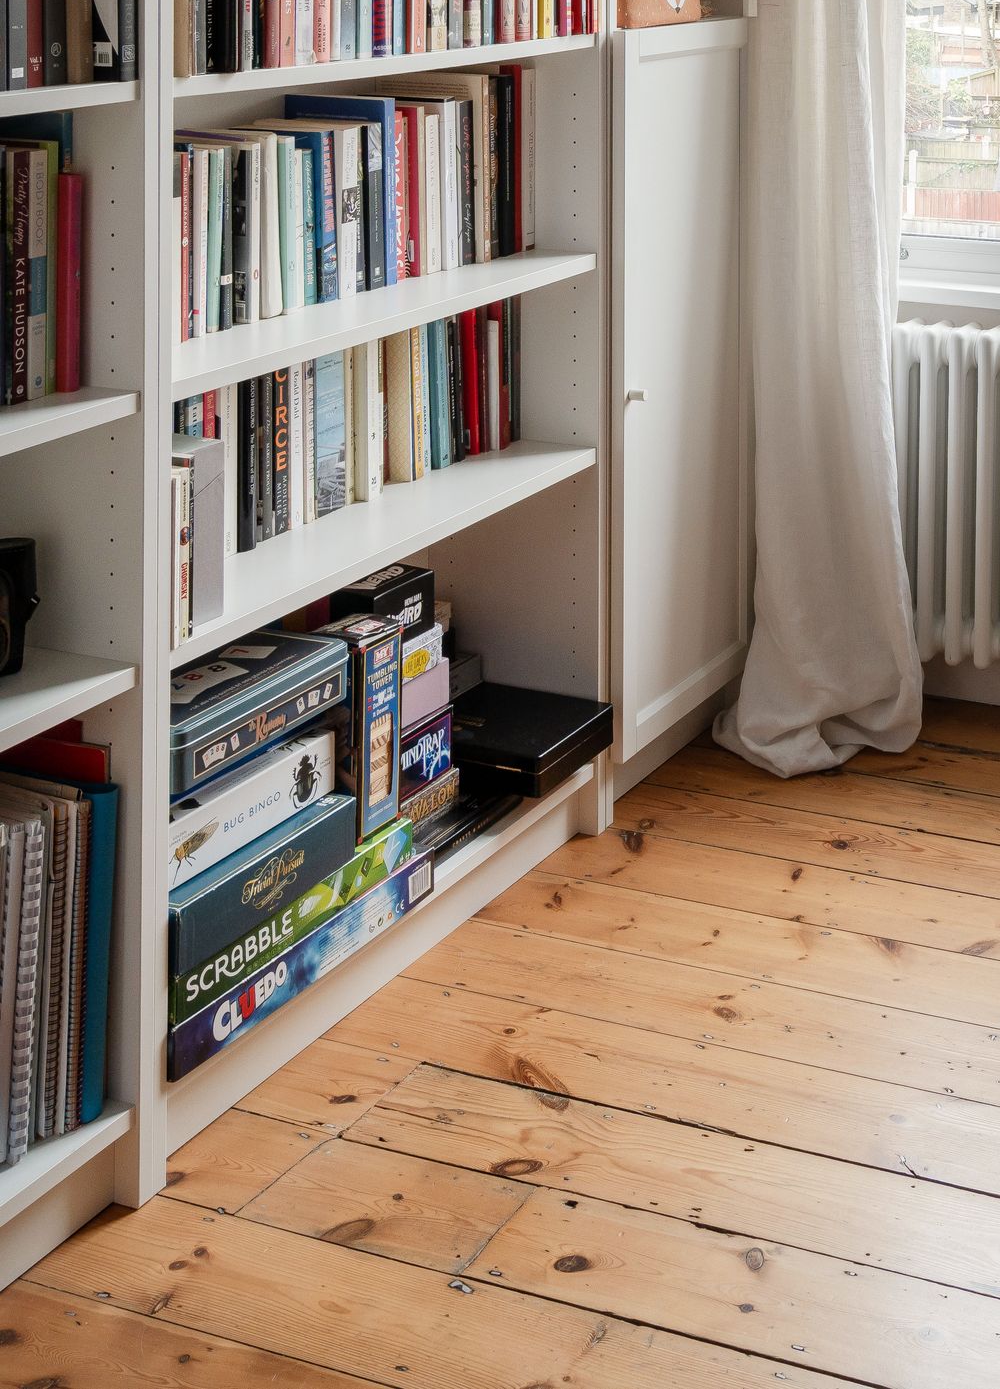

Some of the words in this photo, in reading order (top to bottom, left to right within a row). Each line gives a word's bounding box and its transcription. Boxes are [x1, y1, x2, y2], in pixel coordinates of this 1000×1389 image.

[14, 167, 29, 204] Pretty
[305, 160, 313, 191] Agatha
[322, 137, 333, 196] STEPHEN
[36, 172, 44, 206] BODY
[305, 191, 313, 217] Christie
[15, 204, 28, 245] Happy
[36, 210, 44, 245] BOOK
[324, 198, 335, 232] KING
[15, 257, 25, 296] KATE
[15, 303, 25, 374] HUDSON
[412, 330, 422, 377] TREVOR
[205, 393, 214, 410] Kind
[412, 380, 422, 414] NOAH
[275, 370, 288, 472] CIRCE
[180, 562, 188, 600] CHOMSKY
[367, 661, 398, 683] TUMBLING
[372, 673, 393, 690] TOWER
[223, 812, 245, 832] BUG
[249, 791, 281, 818] BINGO
[241, 860, 275, 904] Trivial
[271, 848, 305, 886] Pursuit
[185, 907, 294, 1002] SCRABBLE
[211, 960, 288, 1042] CLUEDO
